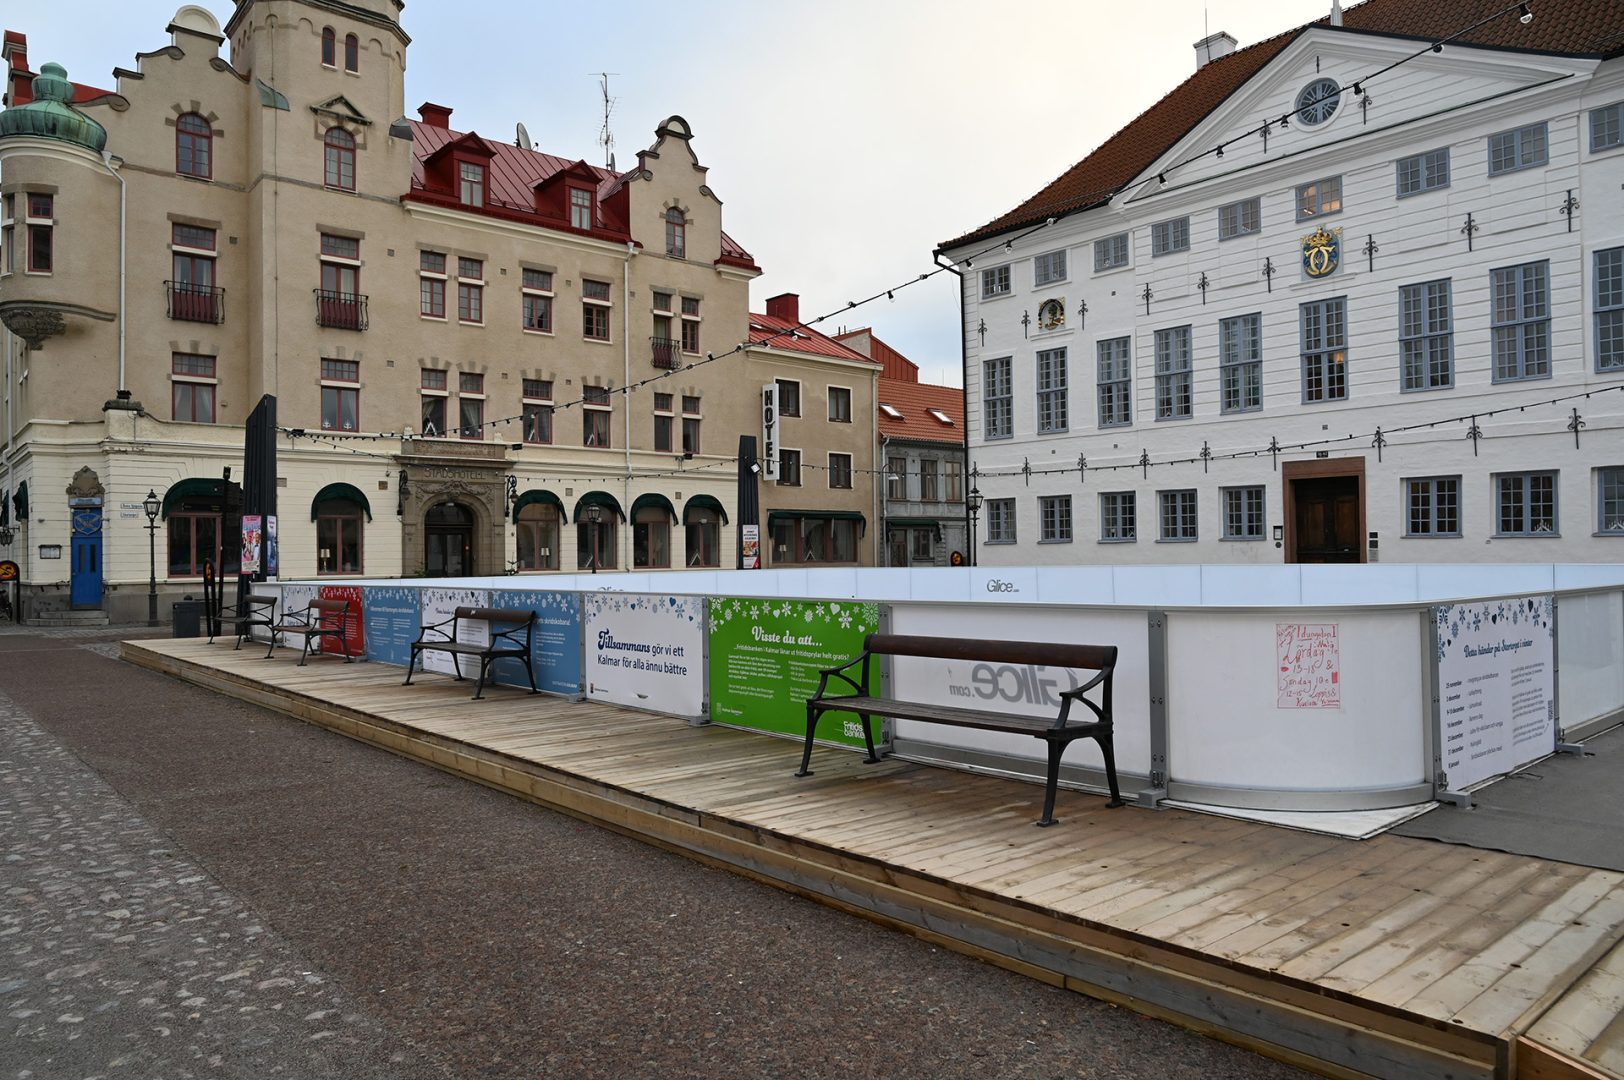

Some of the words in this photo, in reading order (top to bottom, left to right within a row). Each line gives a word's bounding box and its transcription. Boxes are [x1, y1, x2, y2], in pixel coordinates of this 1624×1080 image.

[764, 389, 776, 475] HOTEL
[598, 628, 650, 653] Tillsammans
[652, 643, 664, 657] gör
[665, 645, 672, 655] vi
[672, 646, 684, 657] ett
[751, 625, 781, 643] Visste
[782, 630, 796, 645] du
[797, 634, 823, 647] att...
[765, 646, 779, 654] Kalmar
[779, 647, 790, 655] lånar
[795, 650, 822, 659] fritidsprylar
[1283, 636, 1325, 668] Lördag
[1478, 642, 1494, 655] händer
[1494, 642, 1501, 658] på
[597, 654, 621, 667] Kalmar
[622, 656, 632, 668] för
[632, 658, 645, 670] alla
[645, 660, 663, 672] ännu
[664, 661, 687, 676] bättre
[843, 728, 866, 740] banke
